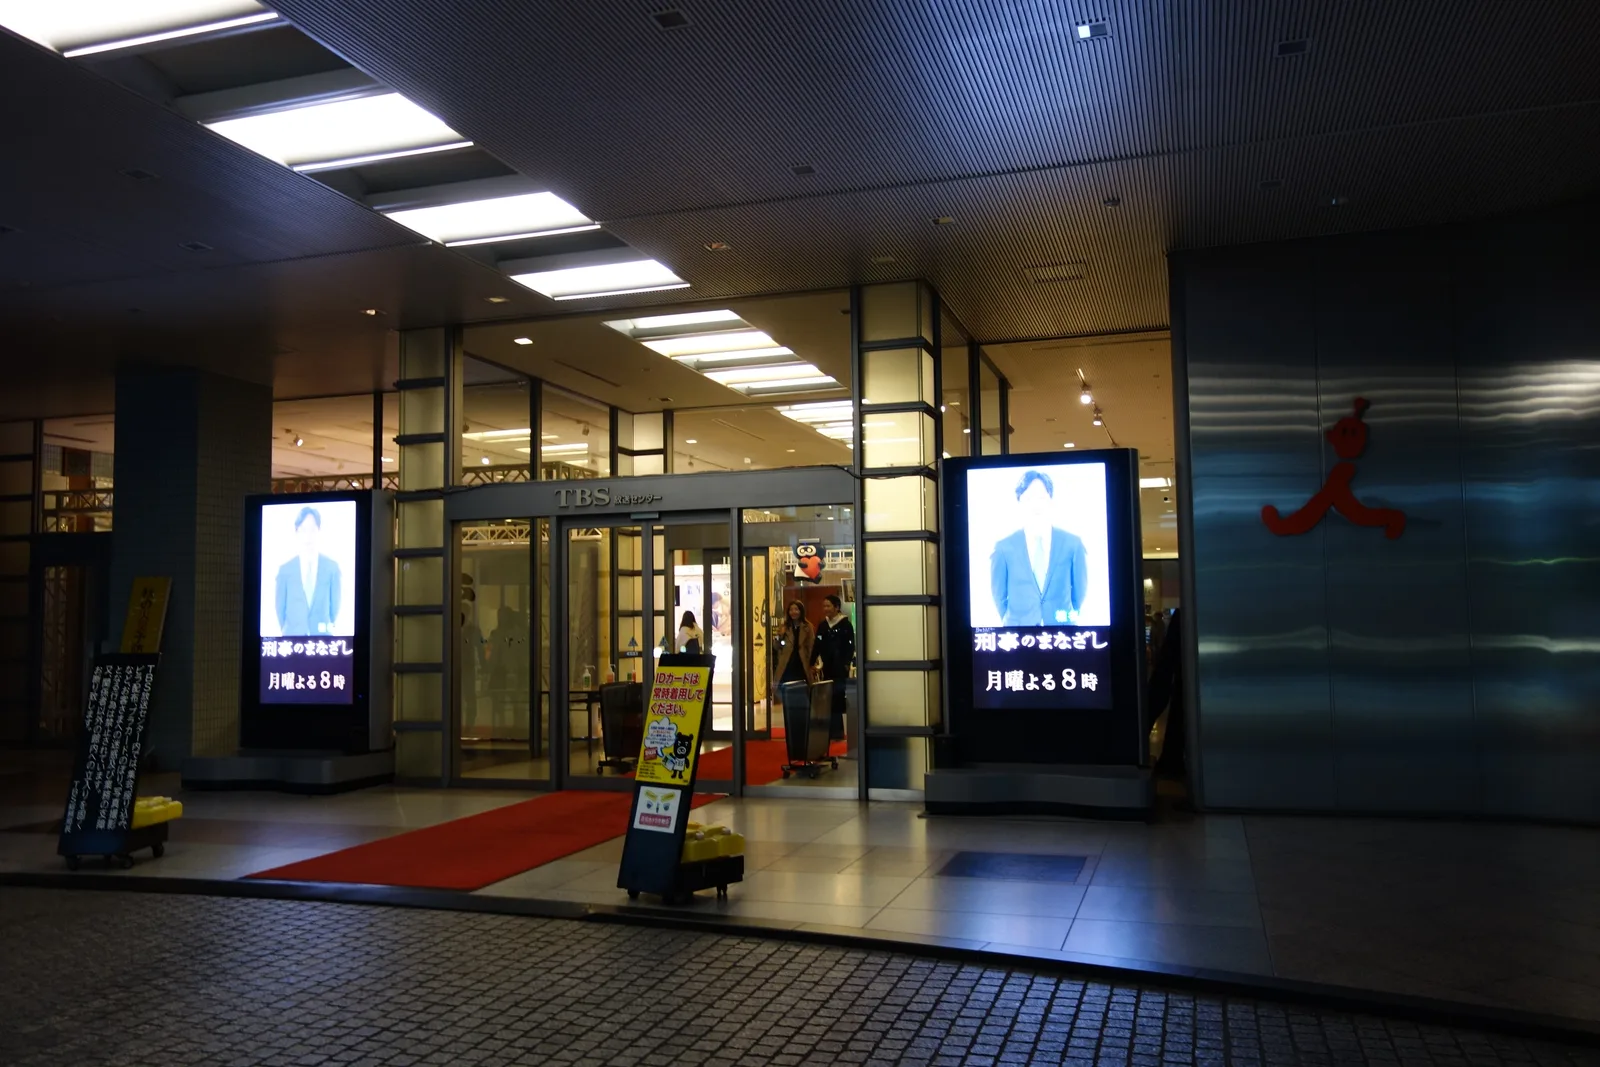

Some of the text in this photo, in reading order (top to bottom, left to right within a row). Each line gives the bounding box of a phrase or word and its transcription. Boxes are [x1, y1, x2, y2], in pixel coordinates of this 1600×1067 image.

[555, 488, 662, 508] TBS 放送センター
[261, 640, 353, 657] 刑事のまなざし
[974, 631, 1108, 651] 刑事のまなざし
[268, 671, 346, 690] 月曜よる8時
[655, 672, 699, 685] IDカードは
[986, 668, 1098, 691] 月曜よる8時
[653, 687, 704, 701] 常時着用して
[650, 702, 686, 717] ください。
